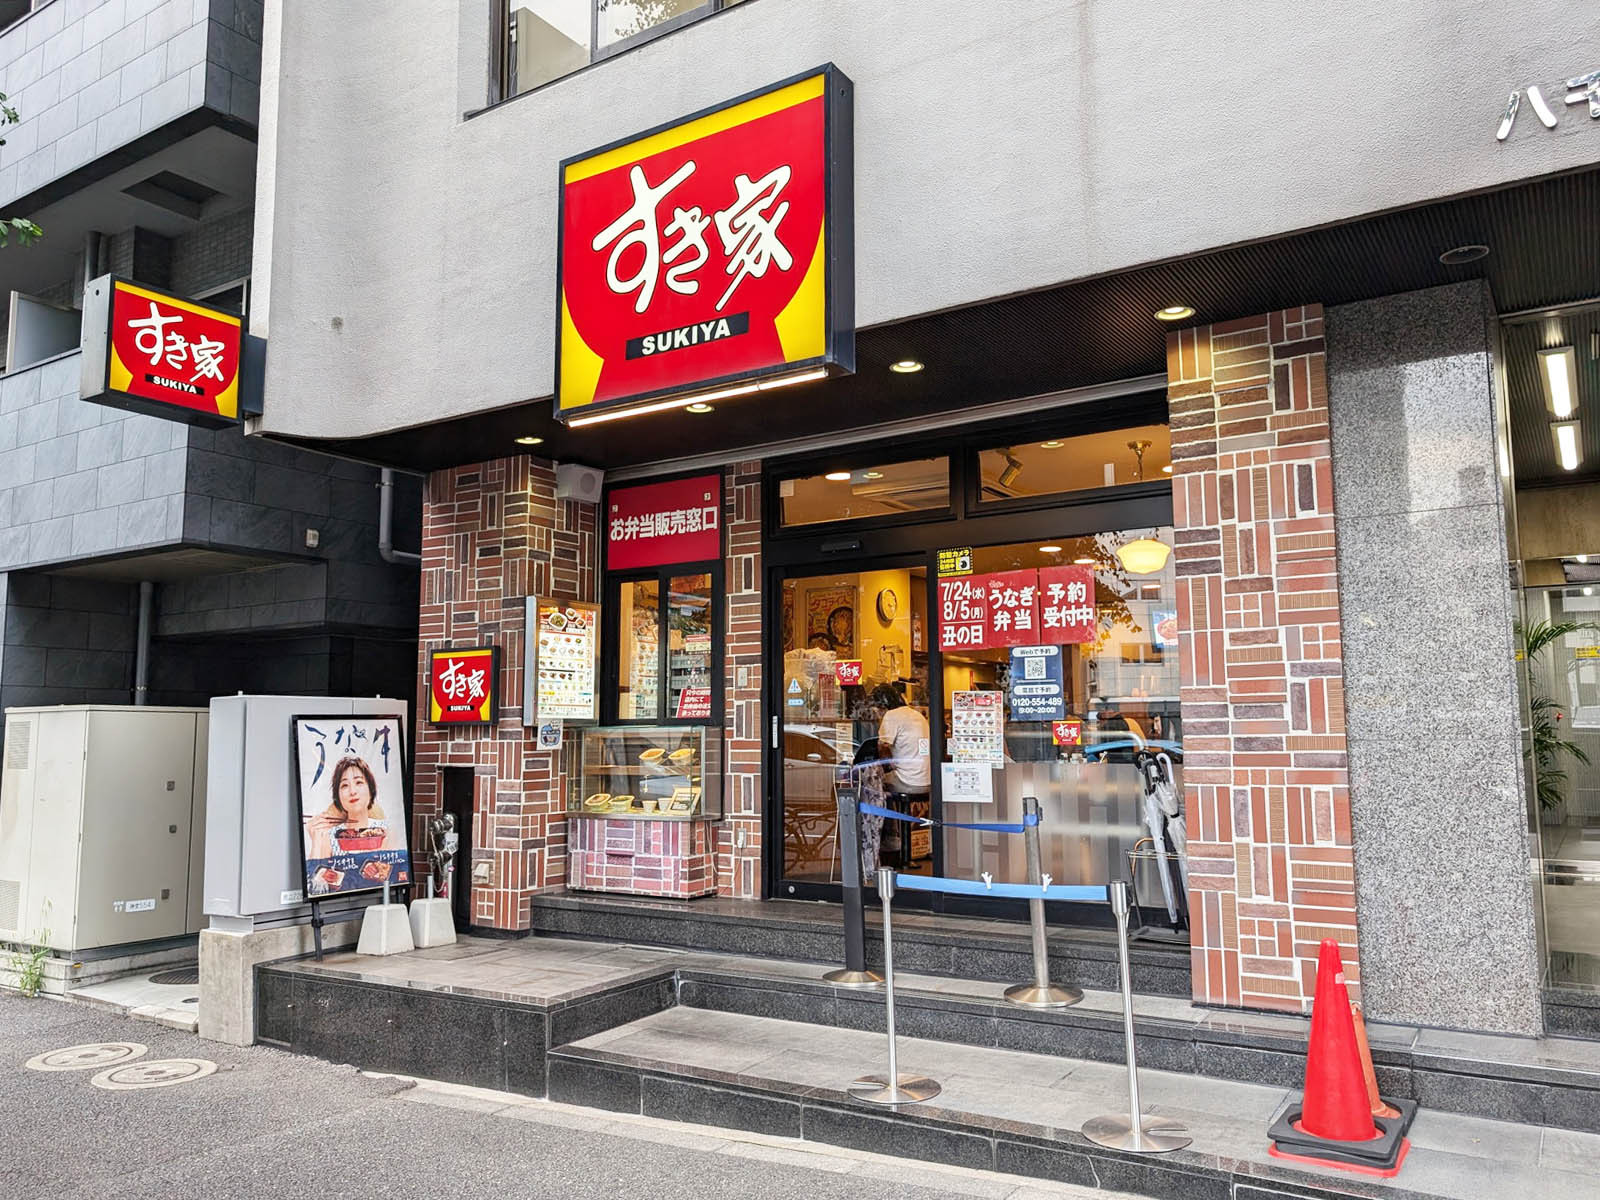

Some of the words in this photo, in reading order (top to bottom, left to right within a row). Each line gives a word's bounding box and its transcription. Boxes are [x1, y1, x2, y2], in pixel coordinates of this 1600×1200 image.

[591, 159, 794, 314] すき家
[127, 301, 225, 383] すき家
[641, 318, 732, 356] SUKIYA
[153, 376, 198, 395] SUKIYA
[610, 506, 718, 541] お弁当販売窓口
[940, 580, 985, 601] 7/24(水)
[988, 585, 1036, 610] うなぎ
[1047, 581, 1087, 605] 予約
[943, 601, 984, 621] 8/5(月)
[993, 608, 1032, 632] 弁当
[1043, 604, 1094, 629] 受付中
[942, 624, 983, 647] 丑の日
[439, 658, 486, 704] すき家
[1012, 696, 1063, 707] 0120-554-489
